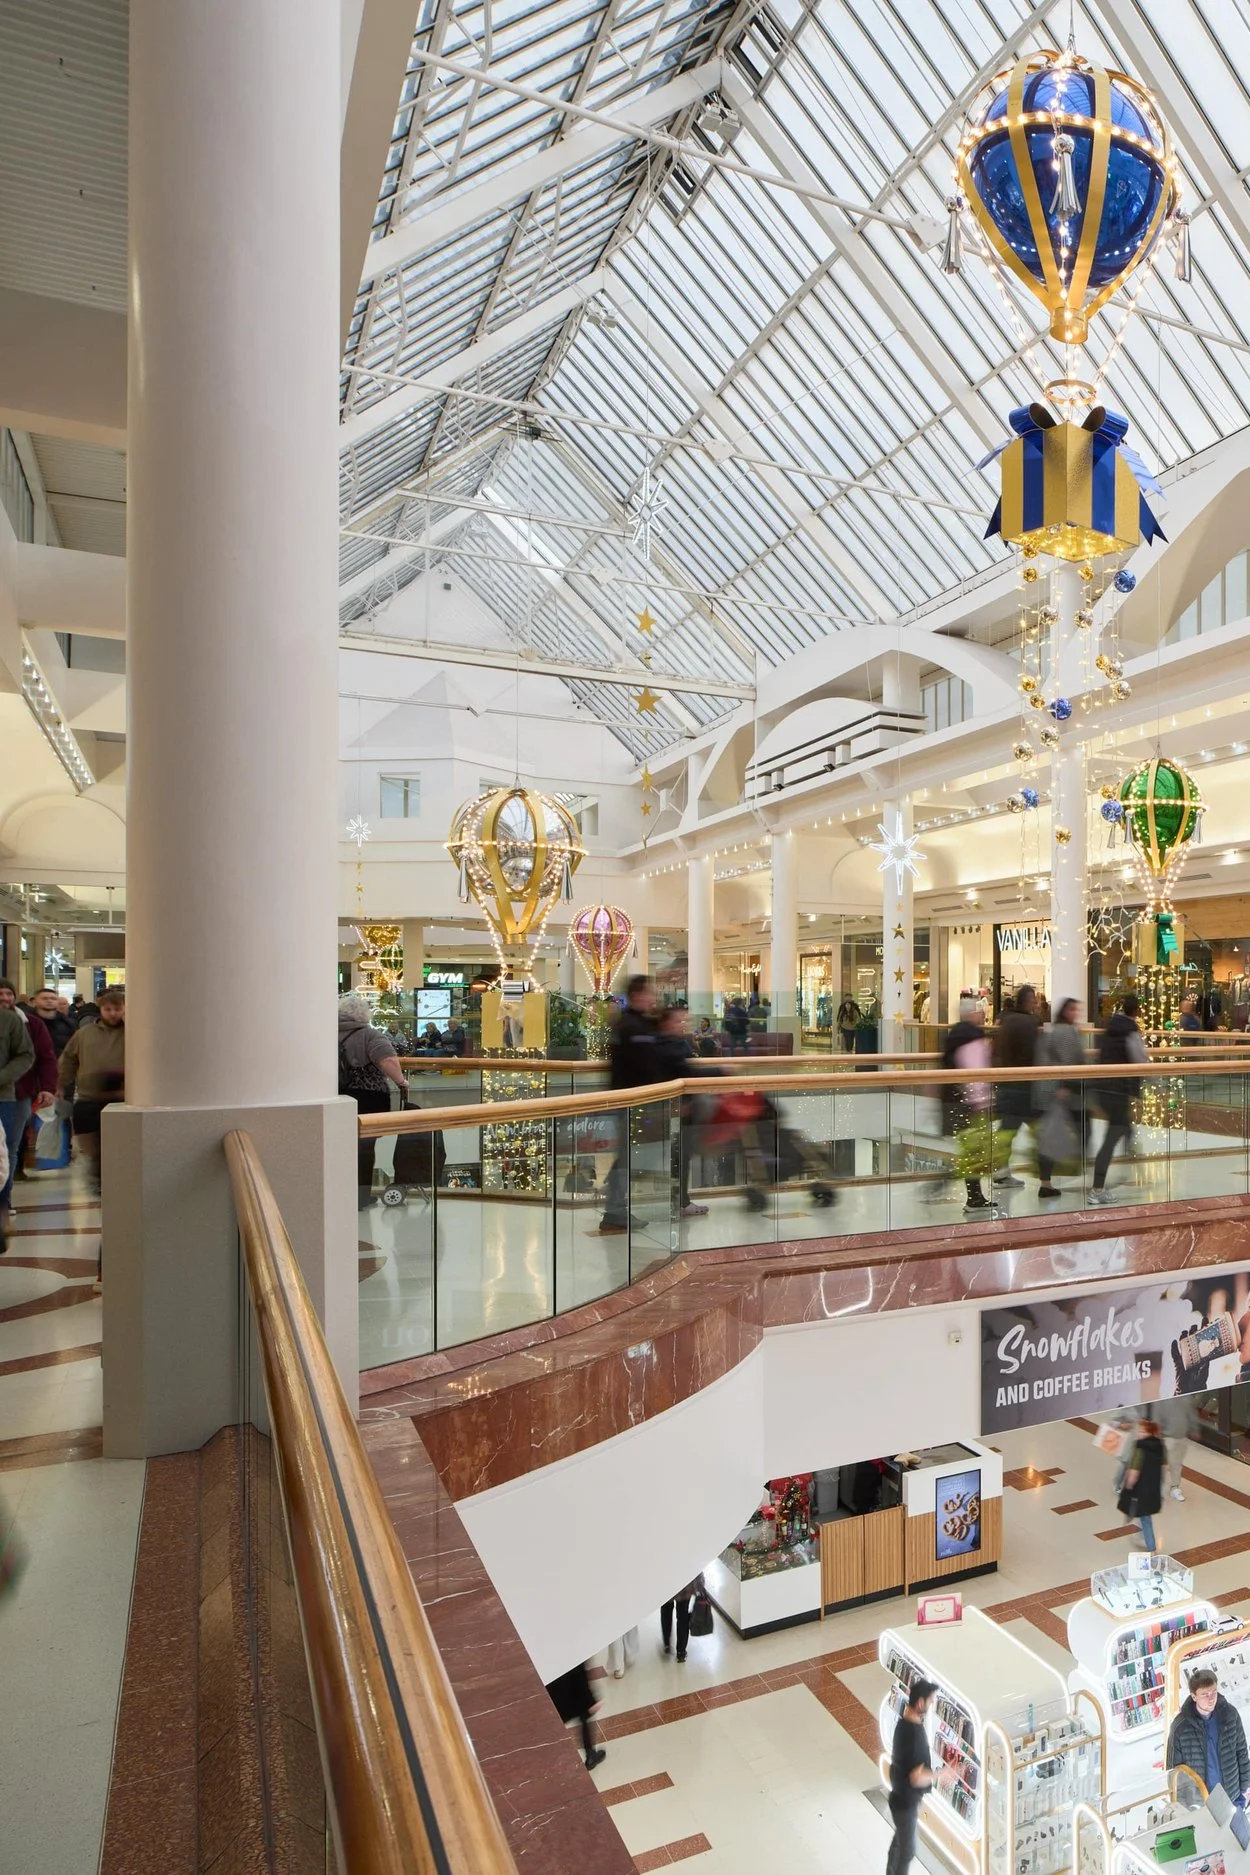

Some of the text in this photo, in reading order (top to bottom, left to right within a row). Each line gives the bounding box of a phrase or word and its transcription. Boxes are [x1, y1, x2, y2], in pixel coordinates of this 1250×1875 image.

[428, 973, 464, 984] GYM
[997, 1306, 1144, 1374] Snowflakes
[995, 1360, 1151, 1407] AND COFFEE BREAKS
